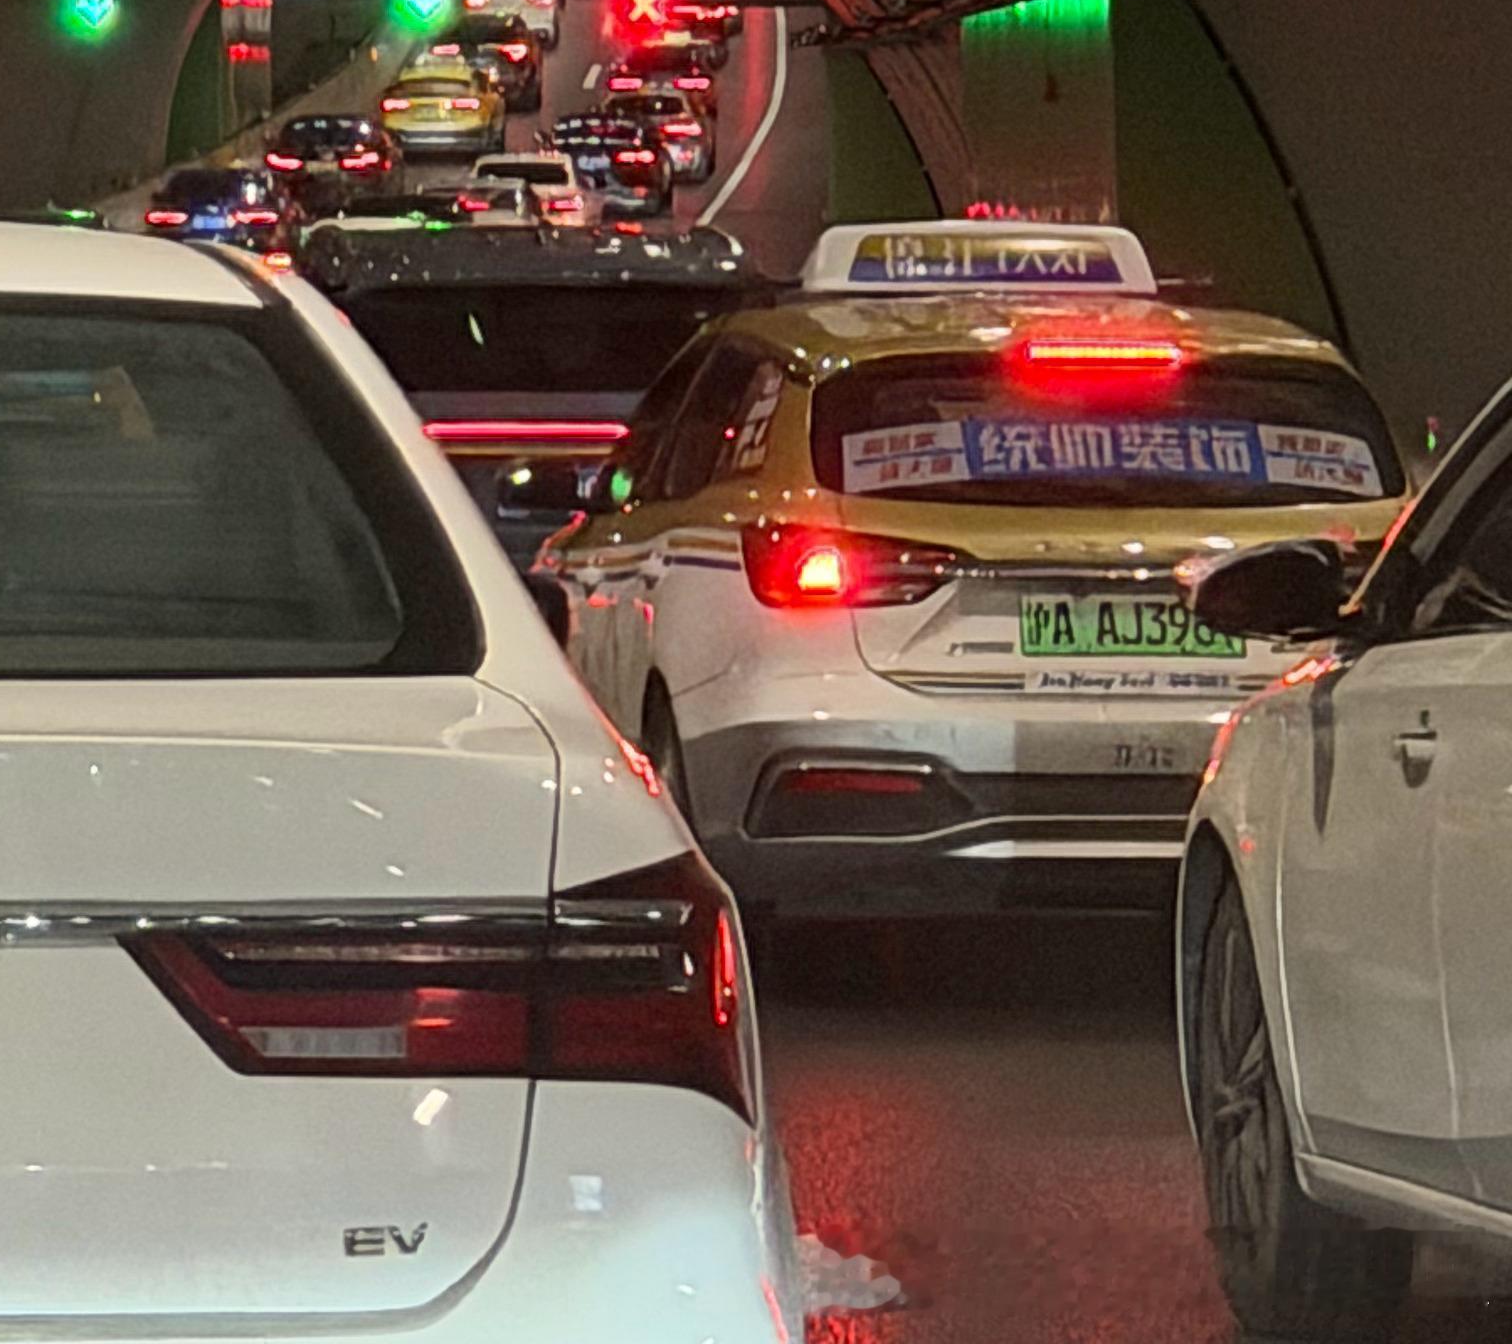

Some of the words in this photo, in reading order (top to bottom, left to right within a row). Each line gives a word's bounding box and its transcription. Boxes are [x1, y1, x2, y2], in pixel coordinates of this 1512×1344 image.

[978, 423, 1252, 473] 统帅装饰
[343, 1222, 429, 1257] EV
